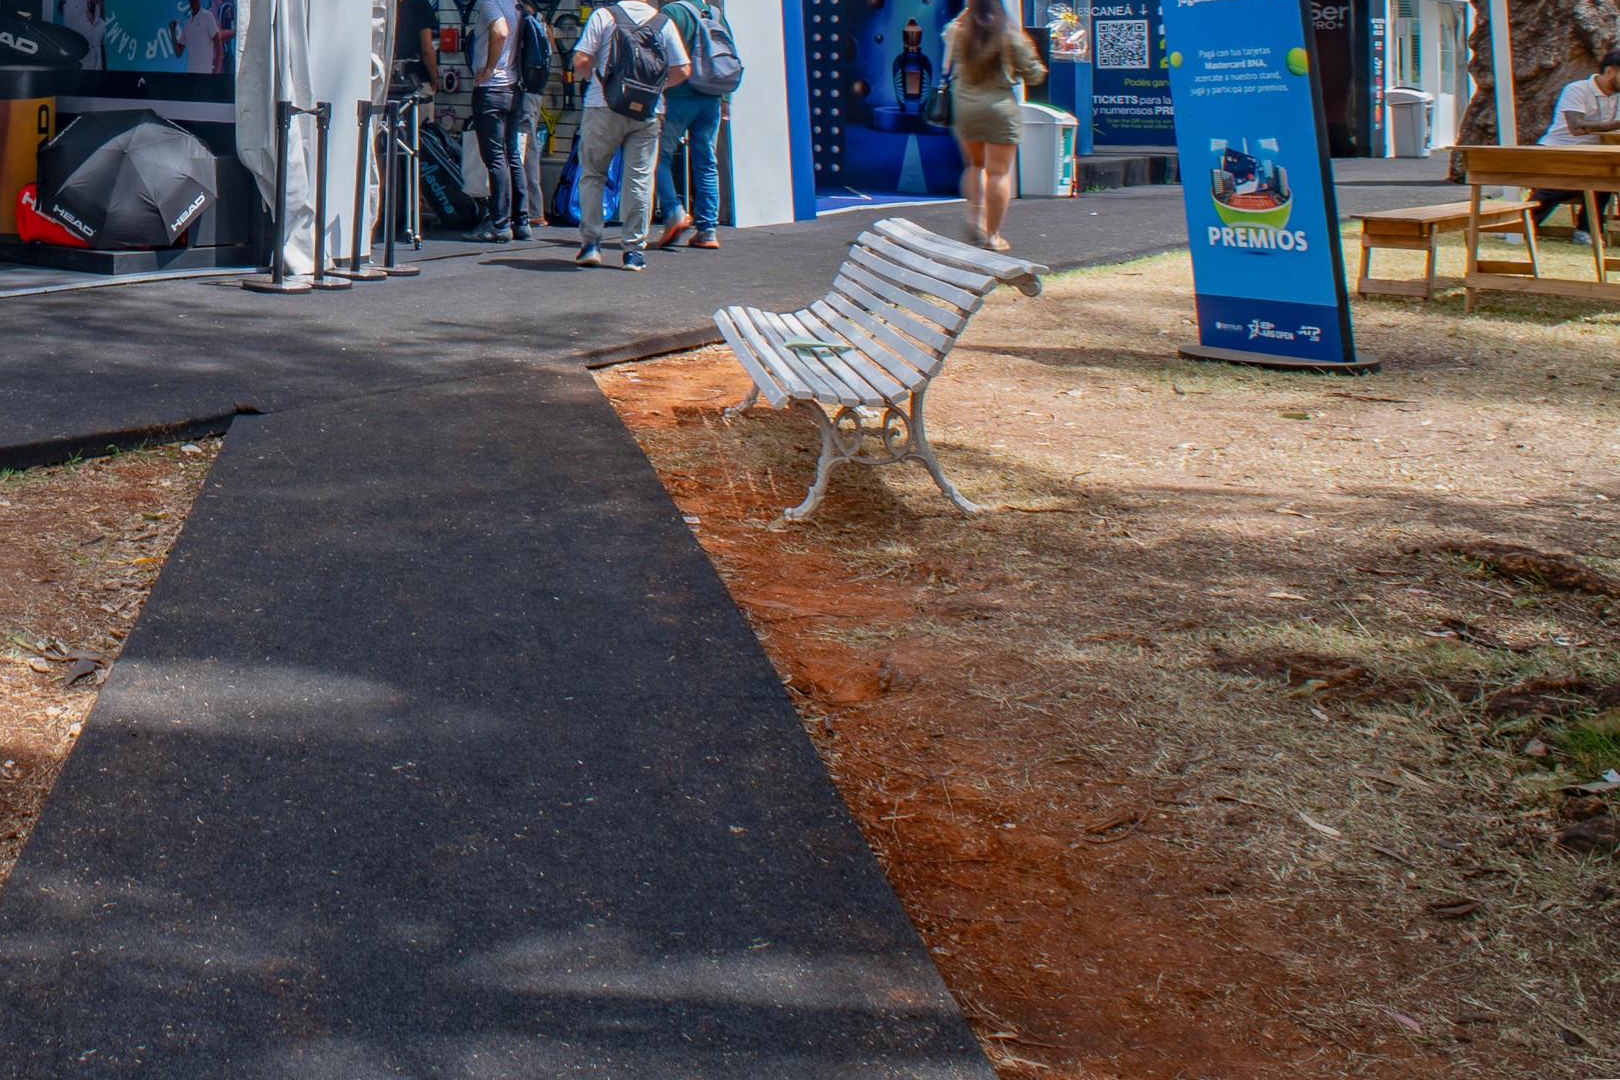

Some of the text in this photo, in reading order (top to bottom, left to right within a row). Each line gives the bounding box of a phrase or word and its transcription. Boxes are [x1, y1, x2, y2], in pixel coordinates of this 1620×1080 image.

[1077, 4, 1133, 16] ESCANEÁ
[1217, 49, 1229, 58] con
[1205, 59, 1267, 70] Mastercard BNA,
[1244, 84, 1256, 94] por
[1092, 95, 1172, 106] TICKETS para la
[1092, 107, 1099, 116] y
[1100, 107, 1154, 115] numerosos
[420, 161, 454, 214] Madma
[170, 193, 206, 232] HEAD
[52, 203, 94, 237] HEAD
[1208, 226, 1308, 251] PREMIOS
